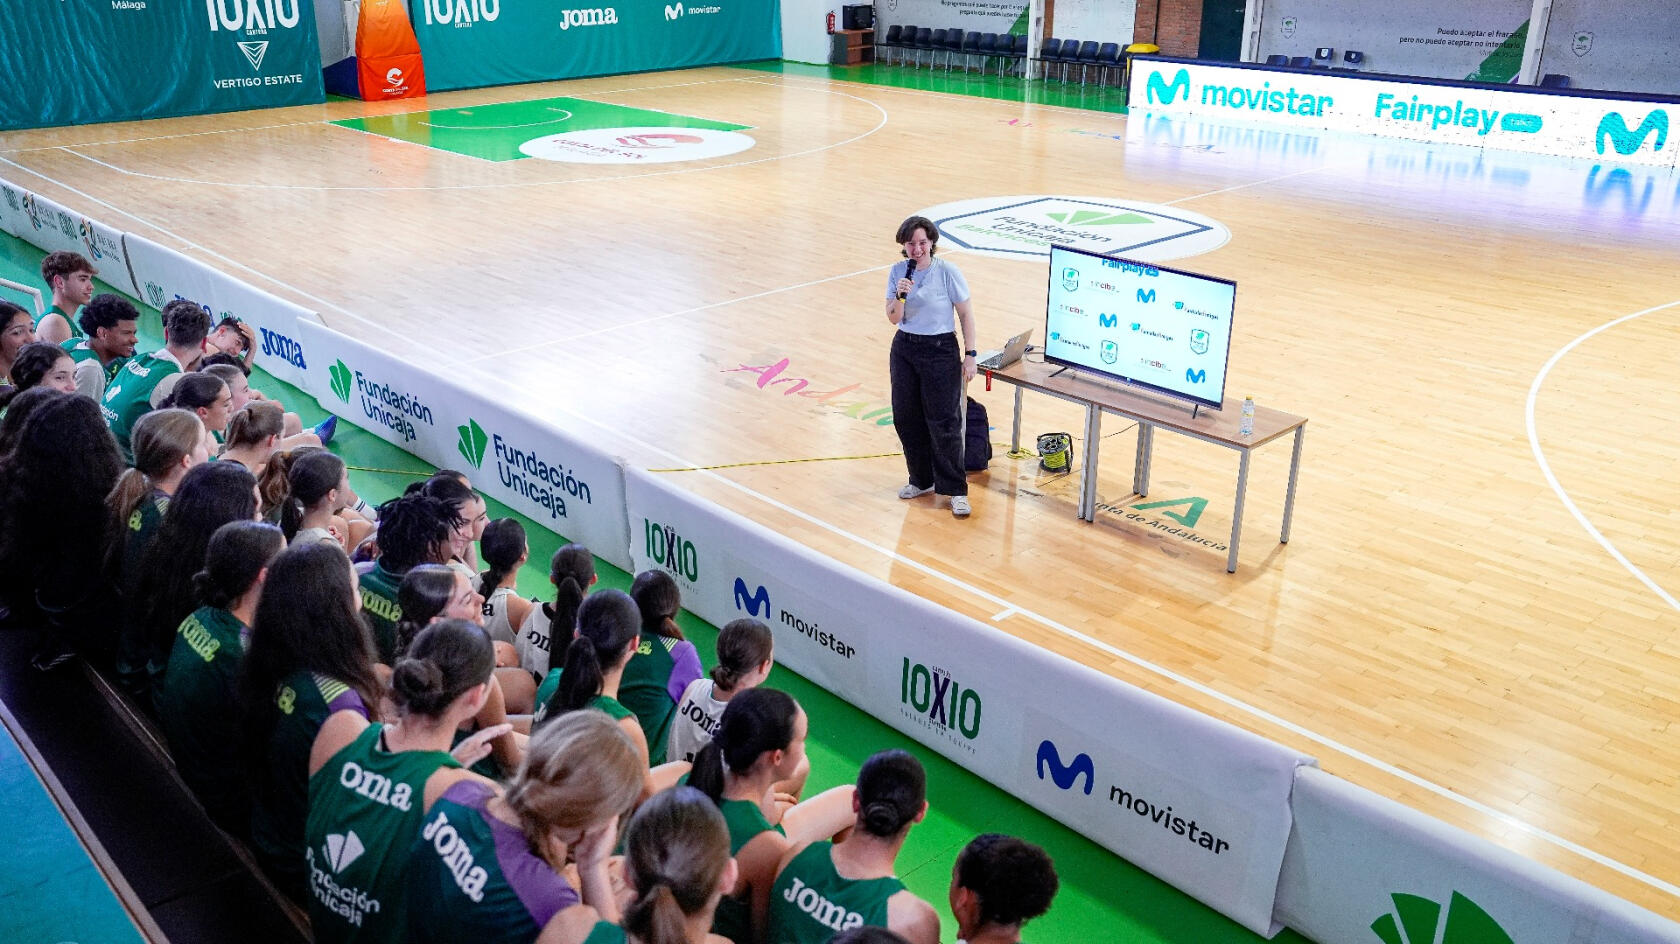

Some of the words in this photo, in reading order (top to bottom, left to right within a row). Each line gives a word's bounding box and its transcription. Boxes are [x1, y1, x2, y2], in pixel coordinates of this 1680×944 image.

[112, 1, 146, 10] Málaga
[688, 6, 720, 14] movistar
[1425, 38, 1446, 46] puedo
[1448, 40, 1473, 48] aceptar
[1437, 28, 1458, 36] Puedo
[214, 78, 262, 89] VERTIGO
[264, 74, 302, 86] ESTATE
[1201, 81, 1334, 117] movistar
[1374, 93, 1500, 136] Fairplay
[994, 216, 1112, 242] Fundación
[355, 370, 434, 426] Fundación
[360, 395, 417, 442] Unicaja
[493, 432, 592, 504] Fundación
[497, 460, 568, 520] Unicaja
[1094, 502, 1124, 515] nta
[1126, 513, 1146, 522] de
[1147, 520, 1228, 552] Andalucía
[780, 608, 856, 659] movistar
[340, 761, 412, 812] oma
[1110, 785, 1230, 856] movistar
[422, 811, 488, 904] Joma
